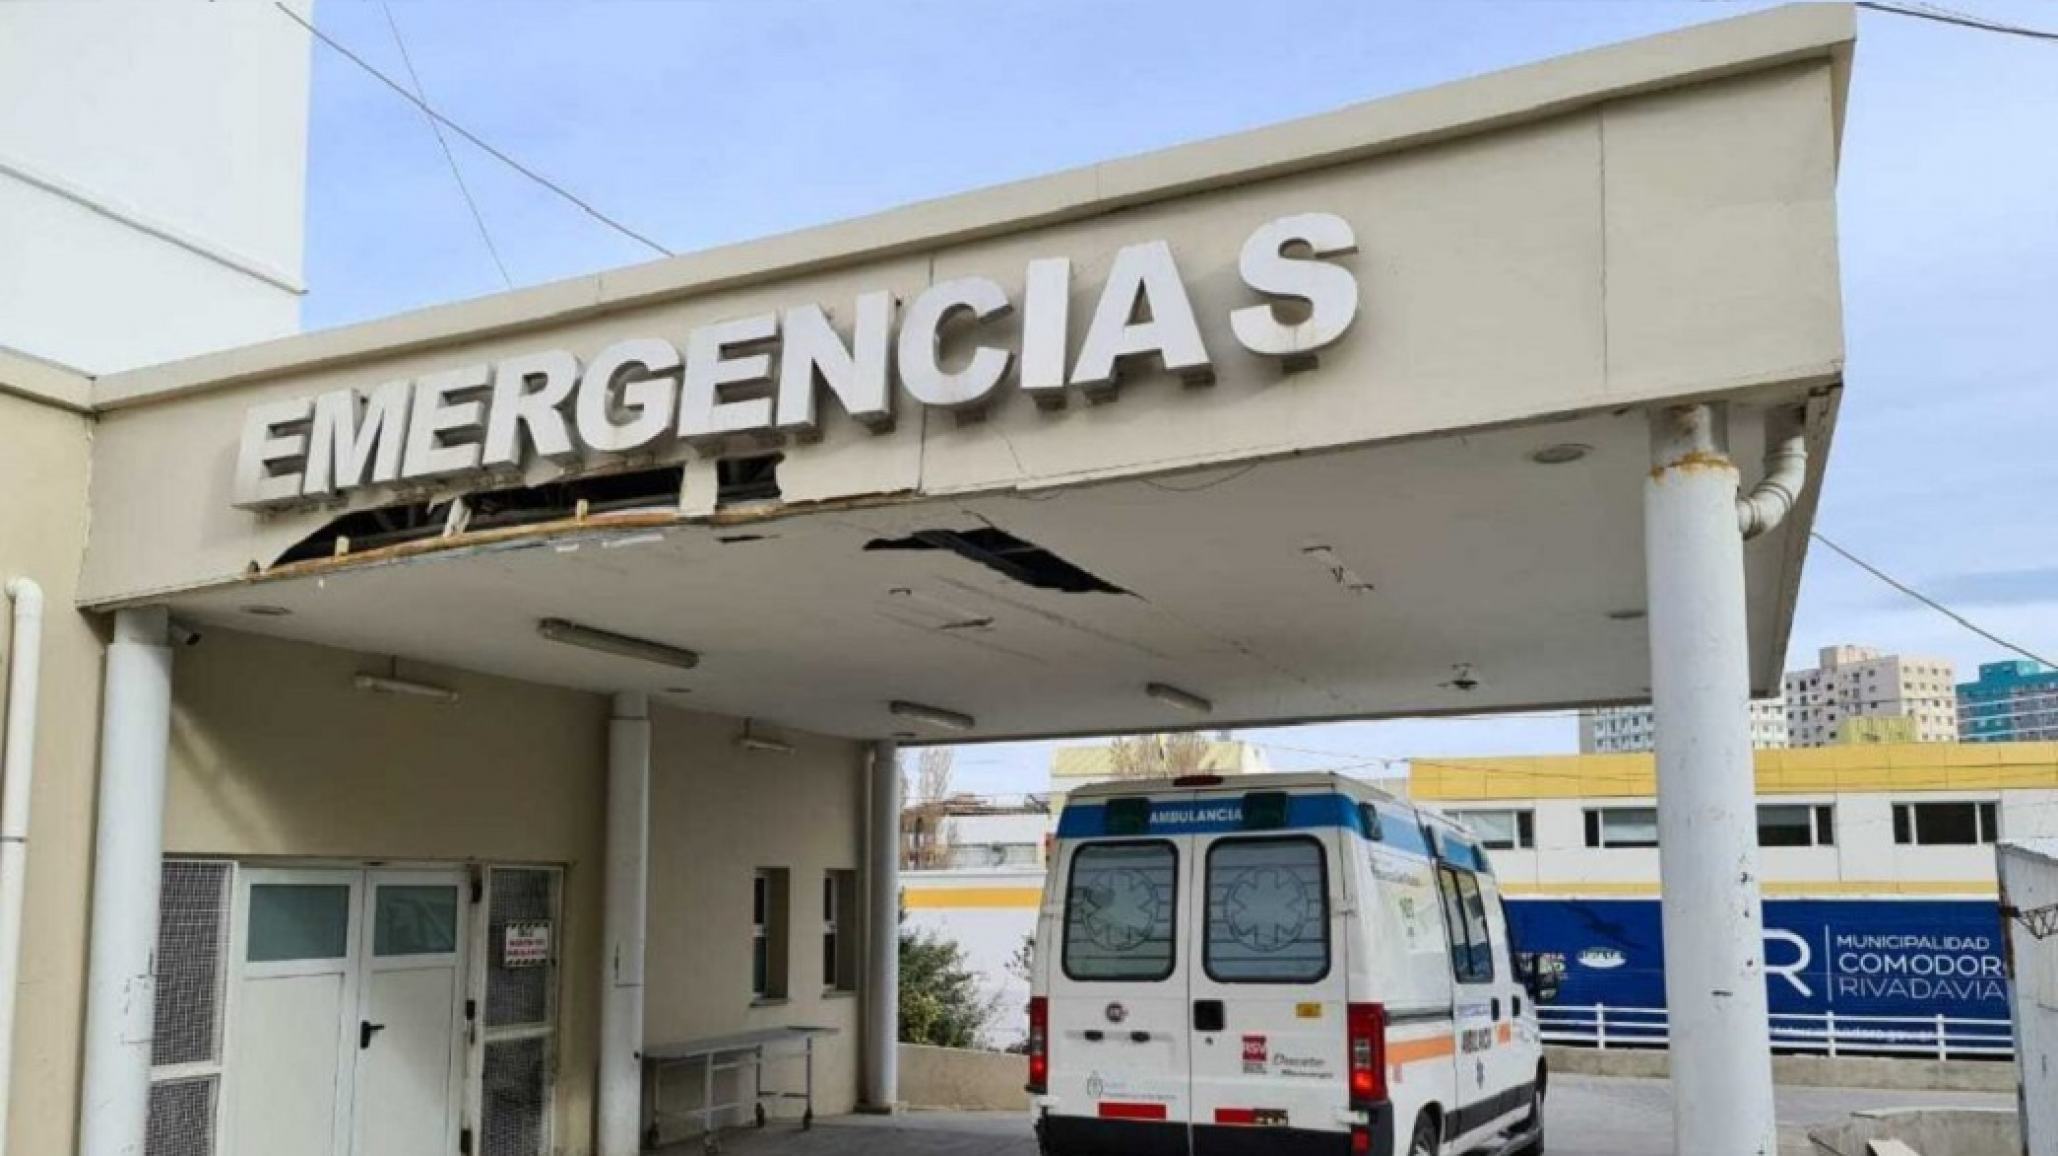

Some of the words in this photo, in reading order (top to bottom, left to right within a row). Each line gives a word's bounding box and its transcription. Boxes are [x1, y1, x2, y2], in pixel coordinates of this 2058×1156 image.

[235, 212, 1359, 511] EMERGENCIAS
[1149, 808, 1244, 824] AMBULANCIA
[1836, 934, 1990, 951] MUNICIPALIDAD
[1838, 952, 2005, 976] COMODOR
[1840, 977, 2007, 1001] RIVADAVIA
